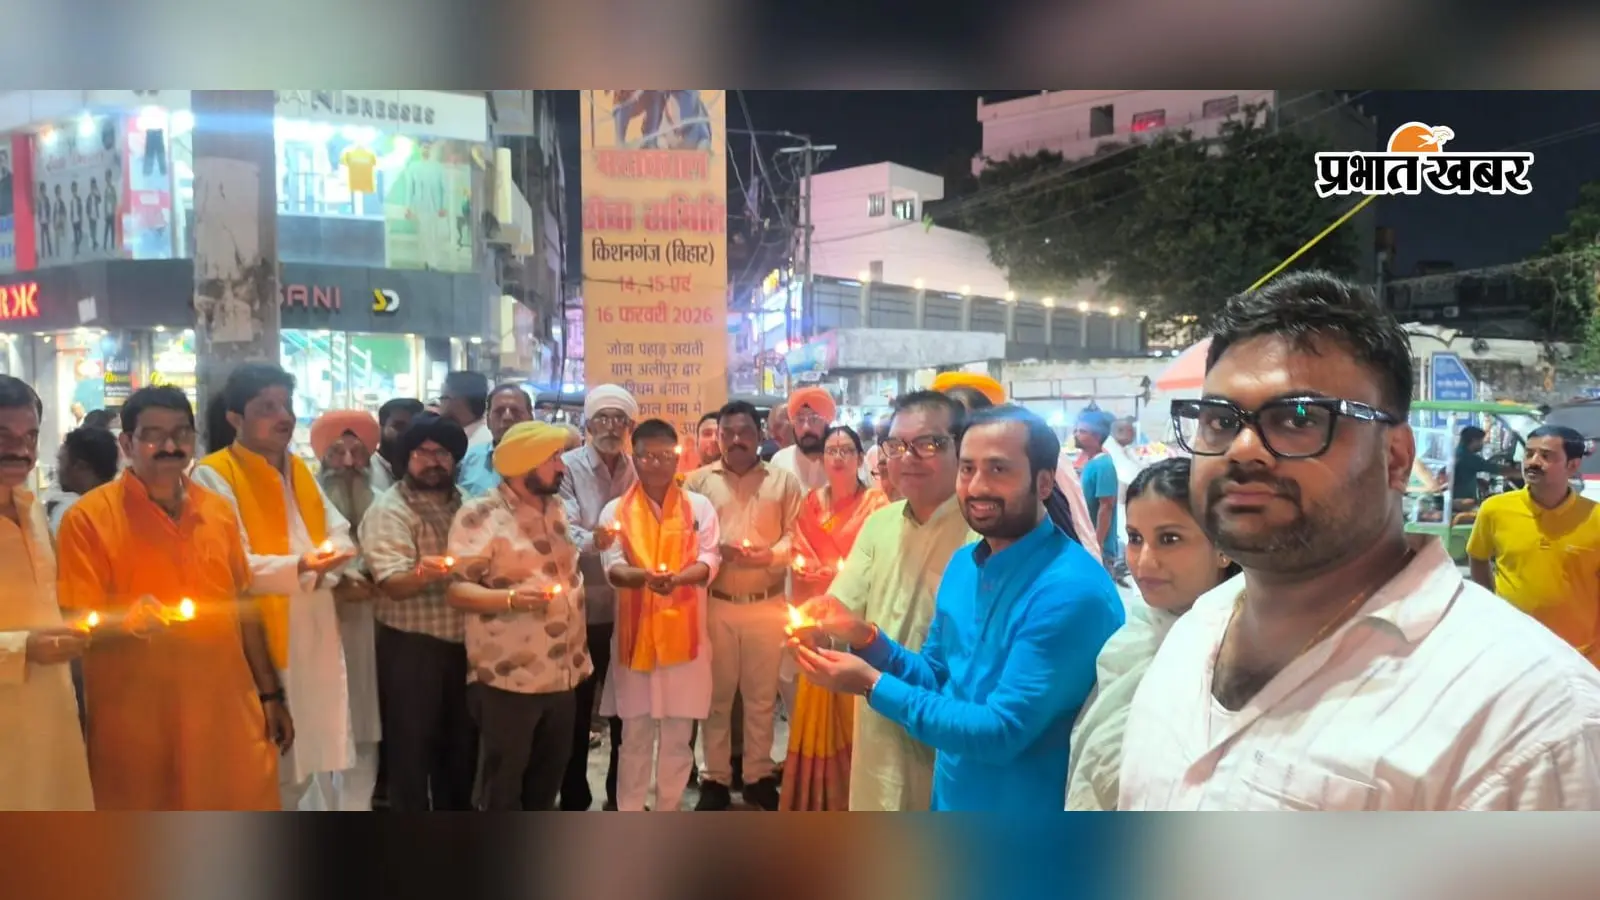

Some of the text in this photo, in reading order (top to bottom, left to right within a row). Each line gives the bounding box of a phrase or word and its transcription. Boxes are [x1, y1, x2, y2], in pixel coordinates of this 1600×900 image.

[345, 95, 435, 125] DRESSES
[592, 236, 715, 266] किशनगंज (बिहार)
[670, 273, 692, 293] एवं
[281, 284, 342, 309] ANI
[596, 300, 713, 324] 16 फरवरी 2026
[638, 358, 678, 379] अलीपुर
[666, 402, 689, 416] धाम
